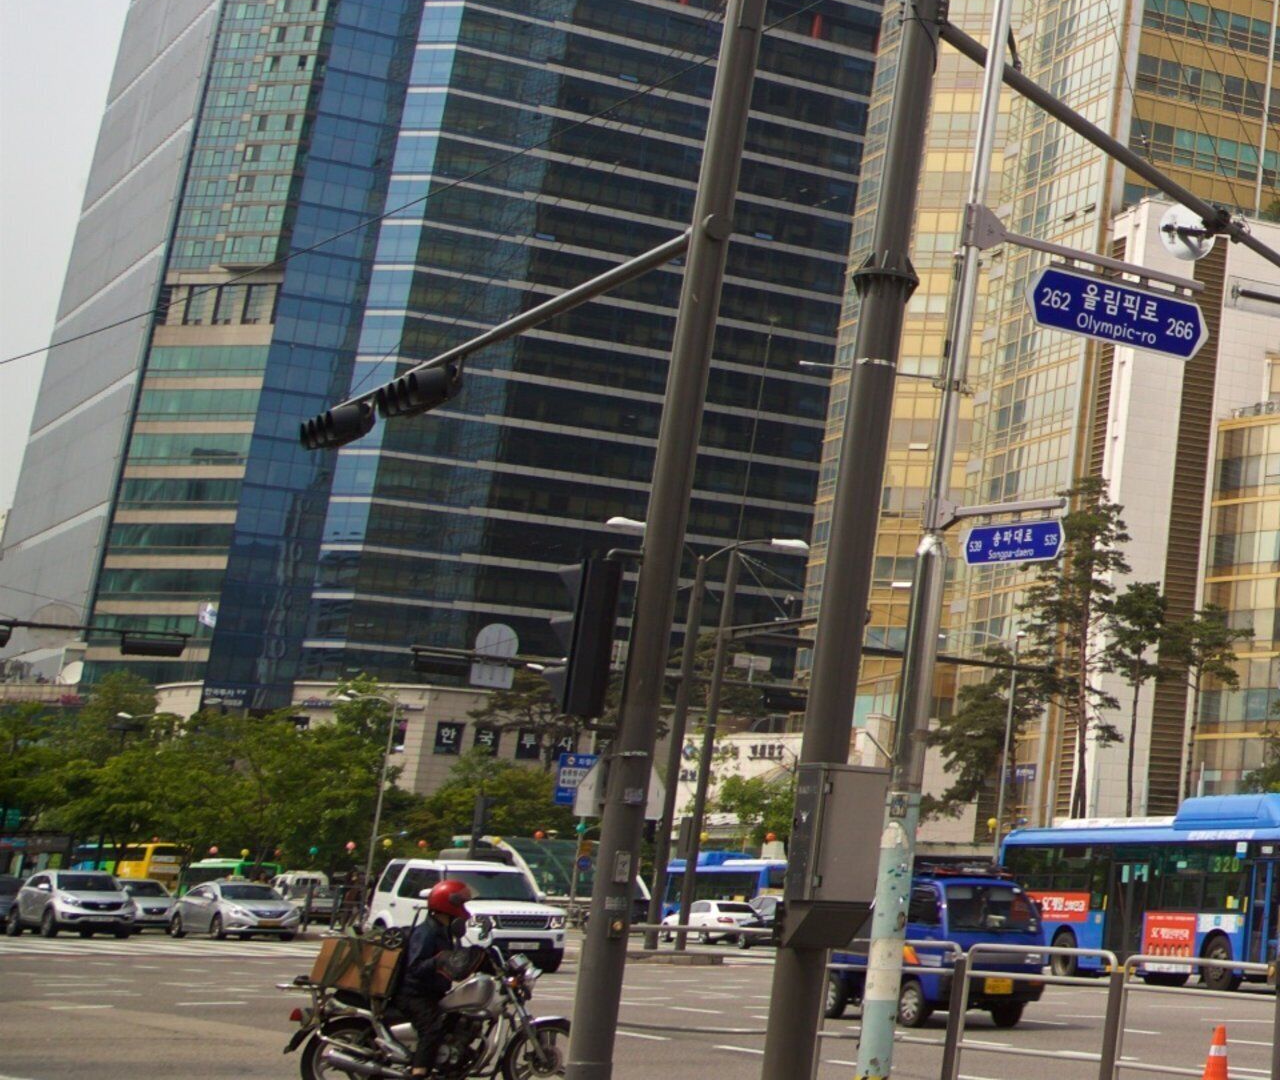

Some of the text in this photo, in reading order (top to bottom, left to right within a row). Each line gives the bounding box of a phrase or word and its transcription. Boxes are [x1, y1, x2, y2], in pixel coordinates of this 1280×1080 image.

[1040, 287, 1072, 312] 262
[1081, 284, 1160, 323] 올림픽로
[1076, 312, 1157, 345] Olympic-ro
[1165, 317, 1195, 340] 266
[993, 528, 1033, 547] 송파대로
[1214, 857, 1240, 872] 320
